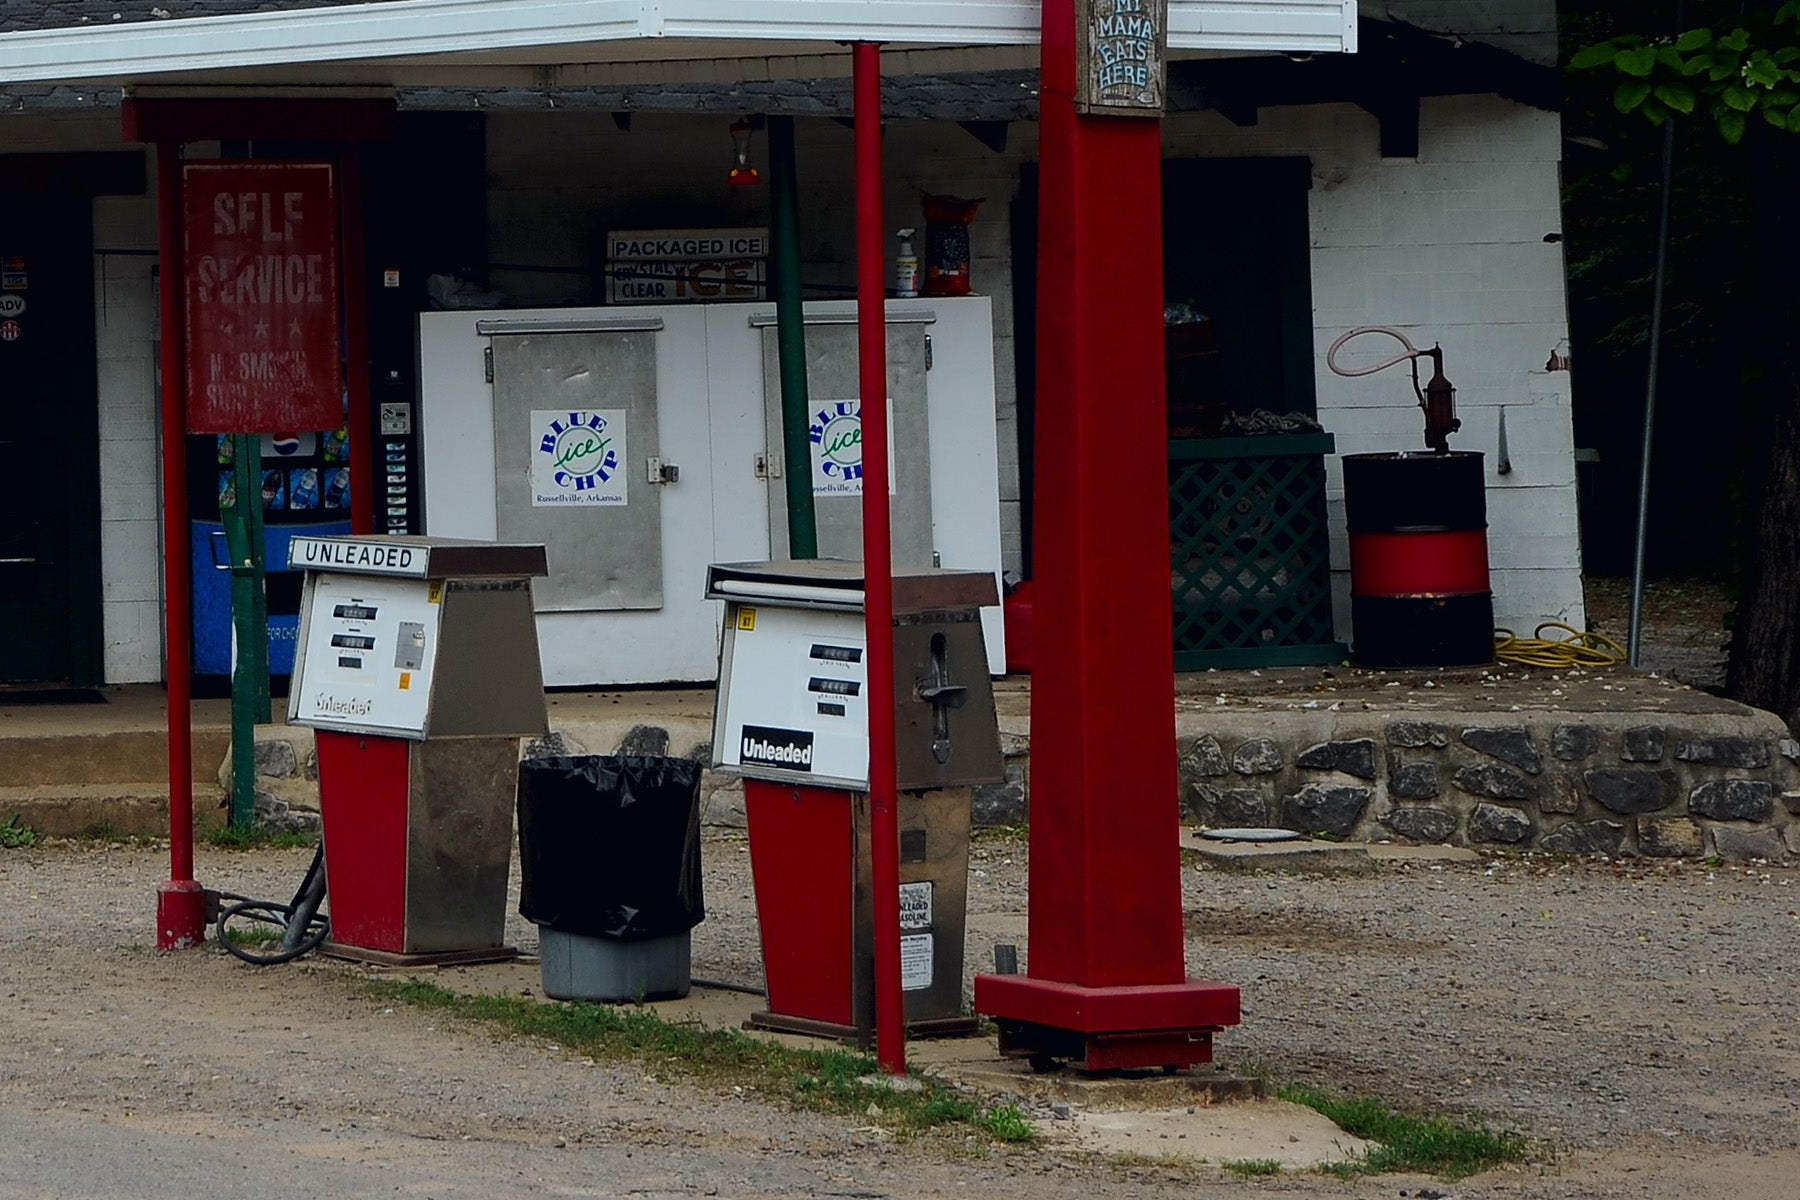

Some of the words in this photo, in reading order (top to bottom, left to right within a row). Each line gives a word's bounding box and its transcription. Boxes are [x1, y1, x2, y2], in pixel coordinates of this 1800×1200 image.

[1098, 15, 1154, 41] MAMA
[1099, 39, 1148, 66] EATS
[1100, 65, 1149, 90] HERE
[615, 240, 723, 256] PACKAGED
[729, 239, 760, 253] ICE
[199, 253, 322, 303] SERVICE
[622, 283, 665, 298] CLEAR
[673, 261, 754, 297] ICE
[540, 412, 607, 455] BLUE
[553, 438, 612, 467] ice
[554, 450, 618, 491] CHIP
[536, 494, 584, 503] Russellville,
[587, 494, 622, 502] Arkansas
[306, 542, 412, 567] UNLEADED
[742, 737, 813, 765] Unleaded
